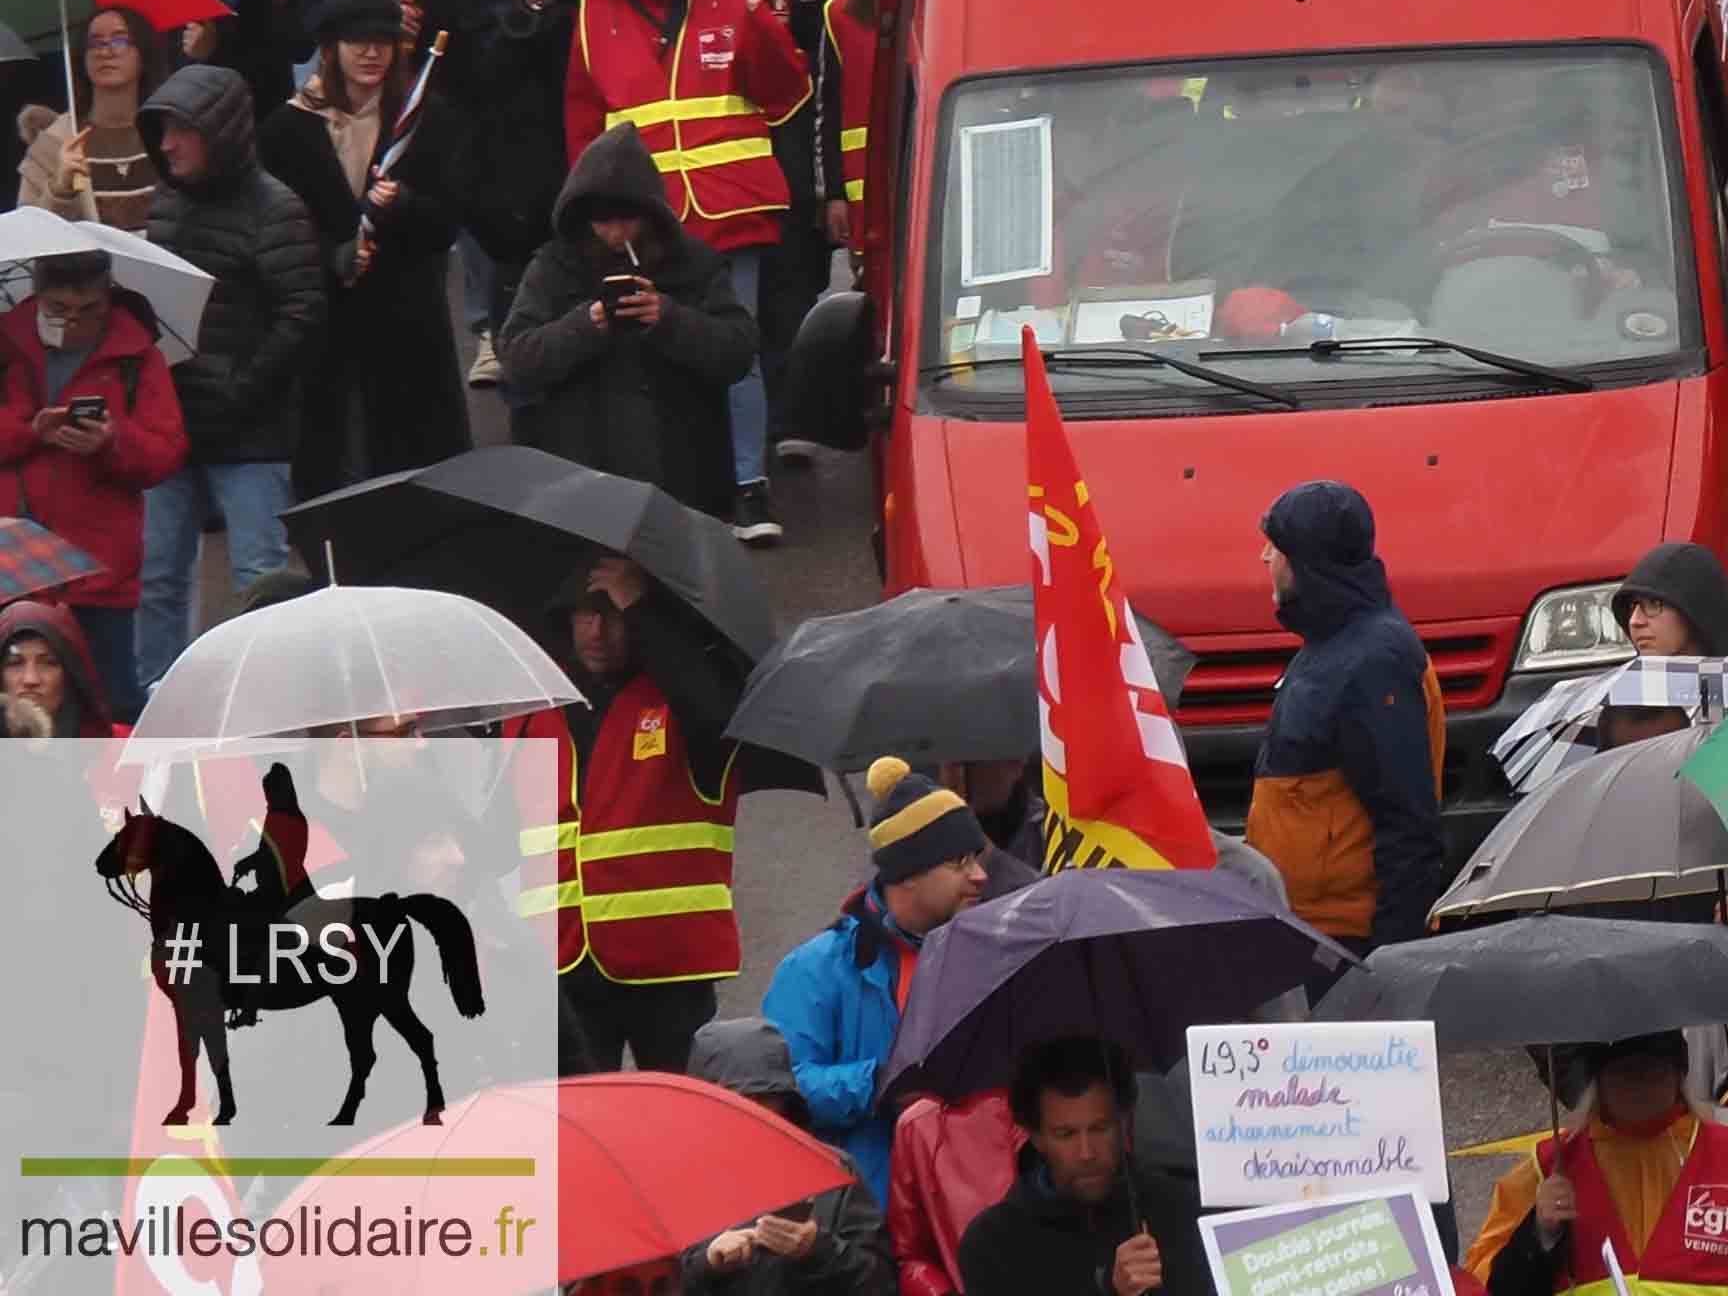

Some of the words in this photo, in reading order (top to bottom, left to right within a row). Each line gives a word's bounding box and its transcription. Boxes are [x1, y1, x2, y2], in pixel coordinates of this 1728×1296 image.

[1282, 1034, 1421, 1072] démocratie
[1236, 1075, 1350, 1109] malade
[1205, 1109, 1362, 1143] acharnement
[1243, 1136, 1420, 1180] déraisonnable
